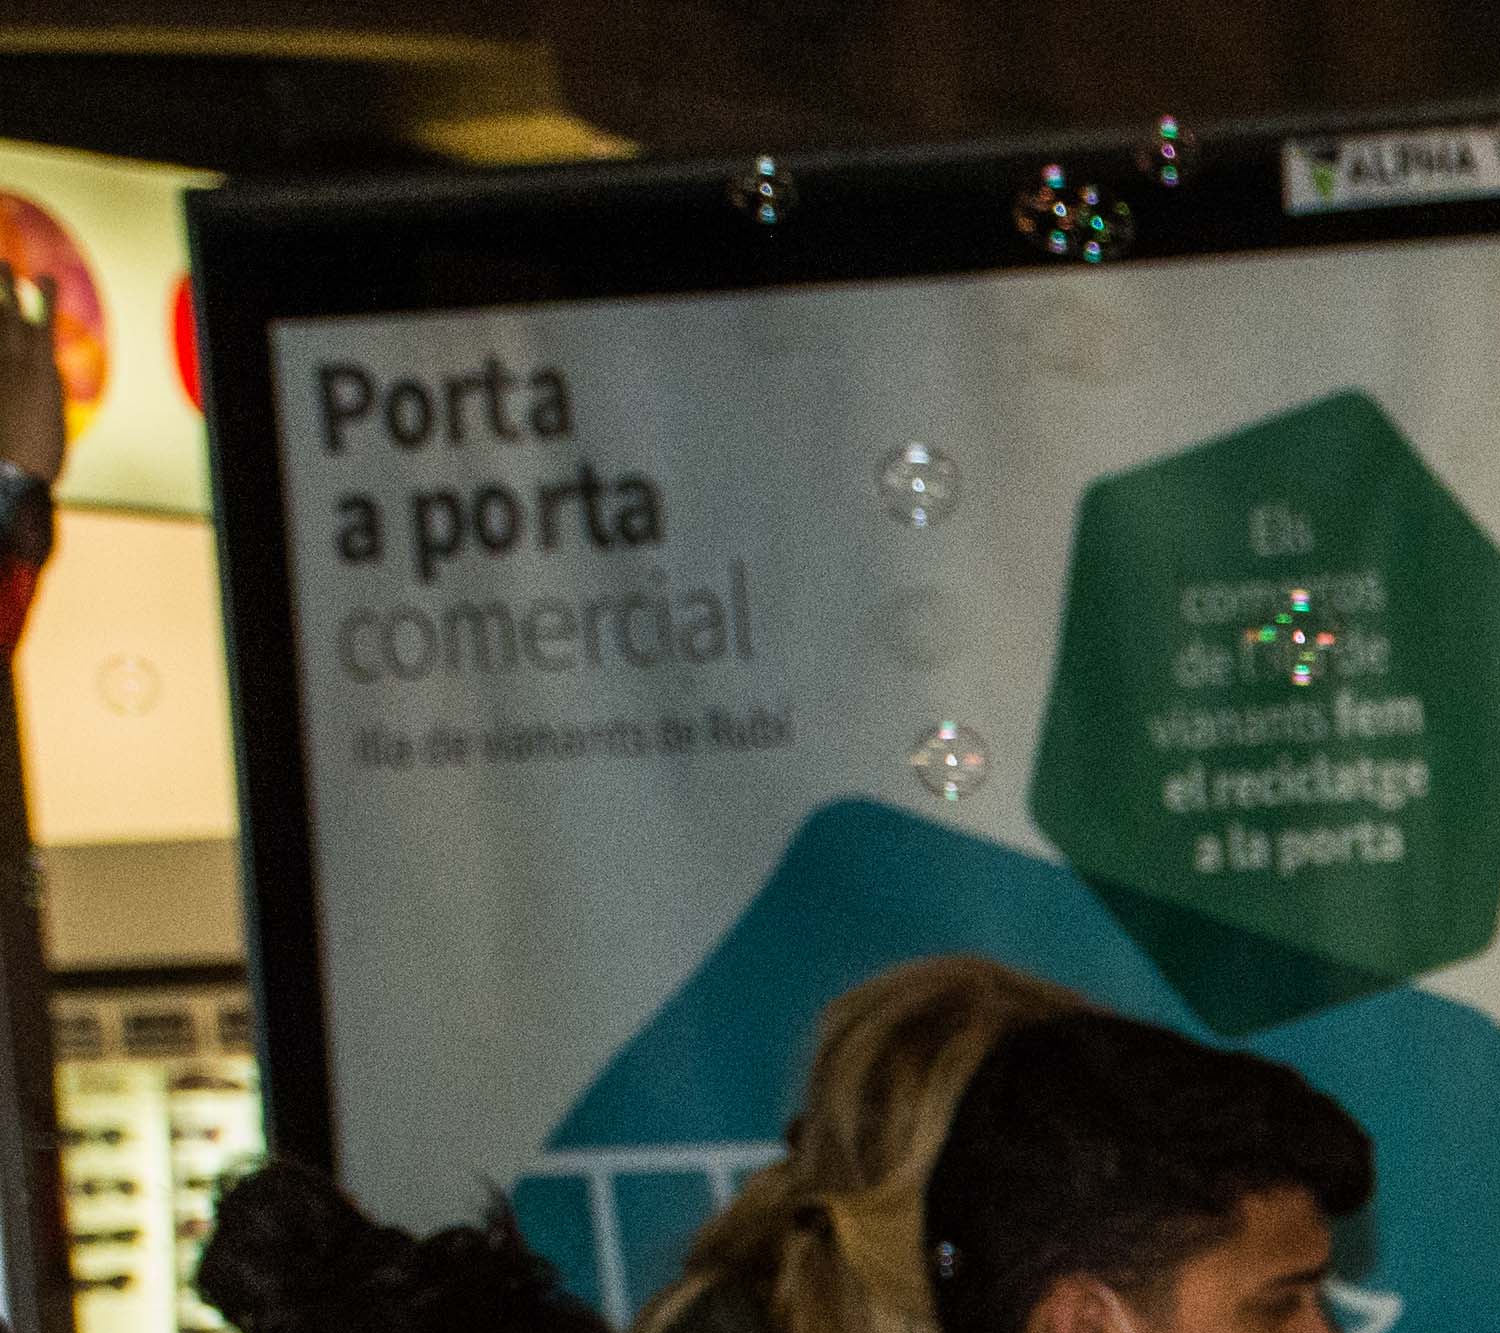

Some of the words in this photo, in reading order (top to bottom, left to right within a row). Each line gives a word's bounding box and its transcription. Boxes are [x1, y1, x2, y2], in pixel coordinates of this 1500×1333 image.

[318, 358, 574, 456] Porta
[336, 492, 385, 566] a
[412, 462, 666, 586] porta
[338, 556, 754, 684] comercial
[1333, 690, 1425, 738] fem
[1163, 758, 1208, 813] el
[1213, 752, 1430, 811] reciclatge
[1195, 832, 1224, 875] a
[1227, 821, 1271, 872] la
[1277, 818, 1405, 879] porta
